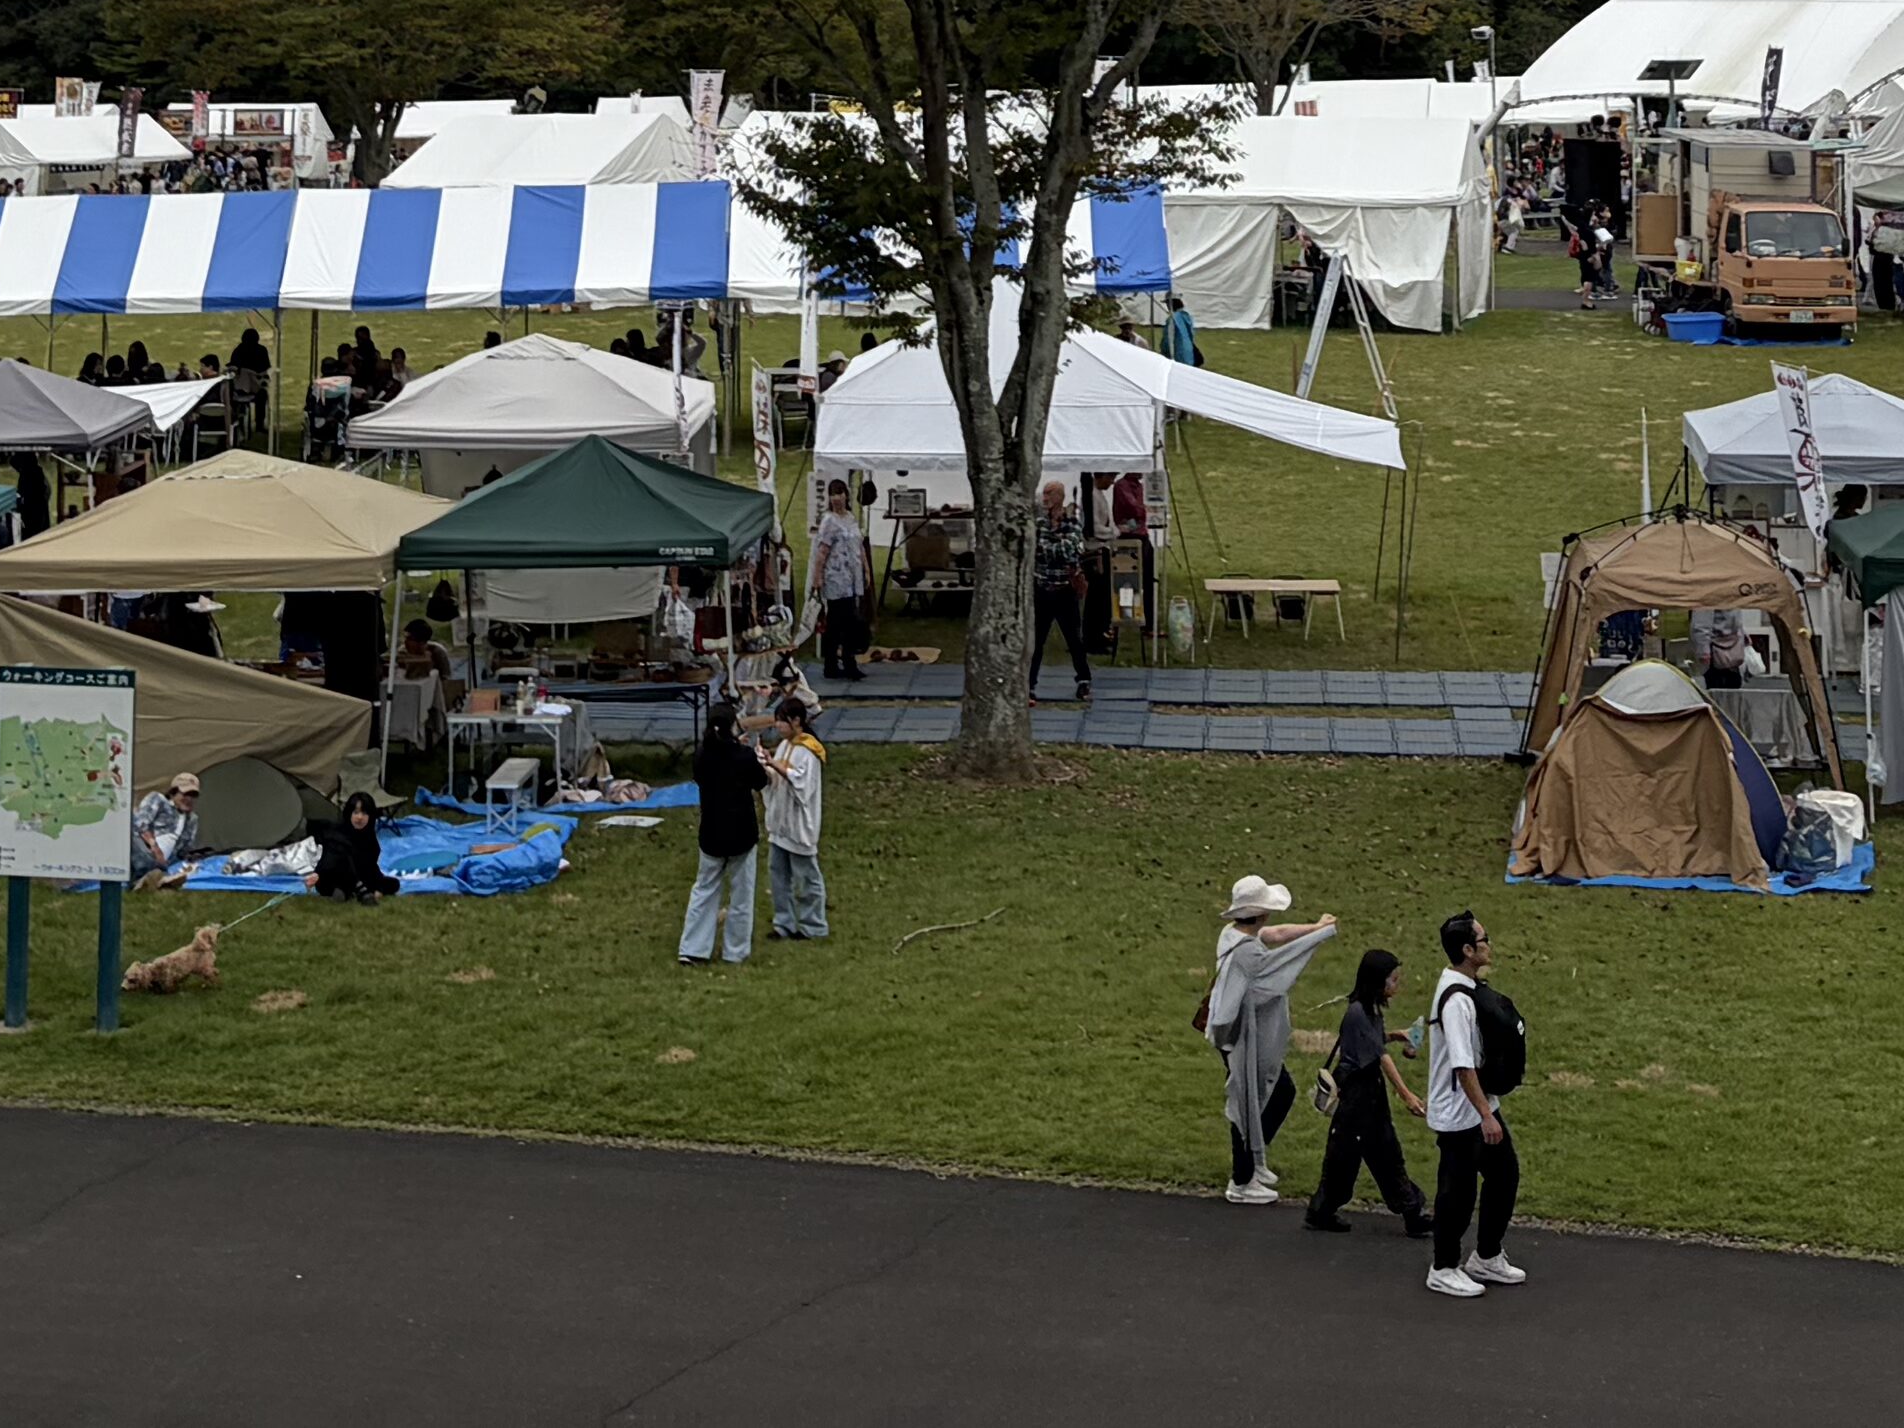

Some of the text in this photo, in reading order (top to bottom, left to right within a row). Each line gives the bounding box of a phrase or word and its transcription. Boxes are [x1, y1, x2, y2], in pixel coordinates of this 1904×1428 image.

[2, 669, 129, 686] ウォーキングコースご案内
